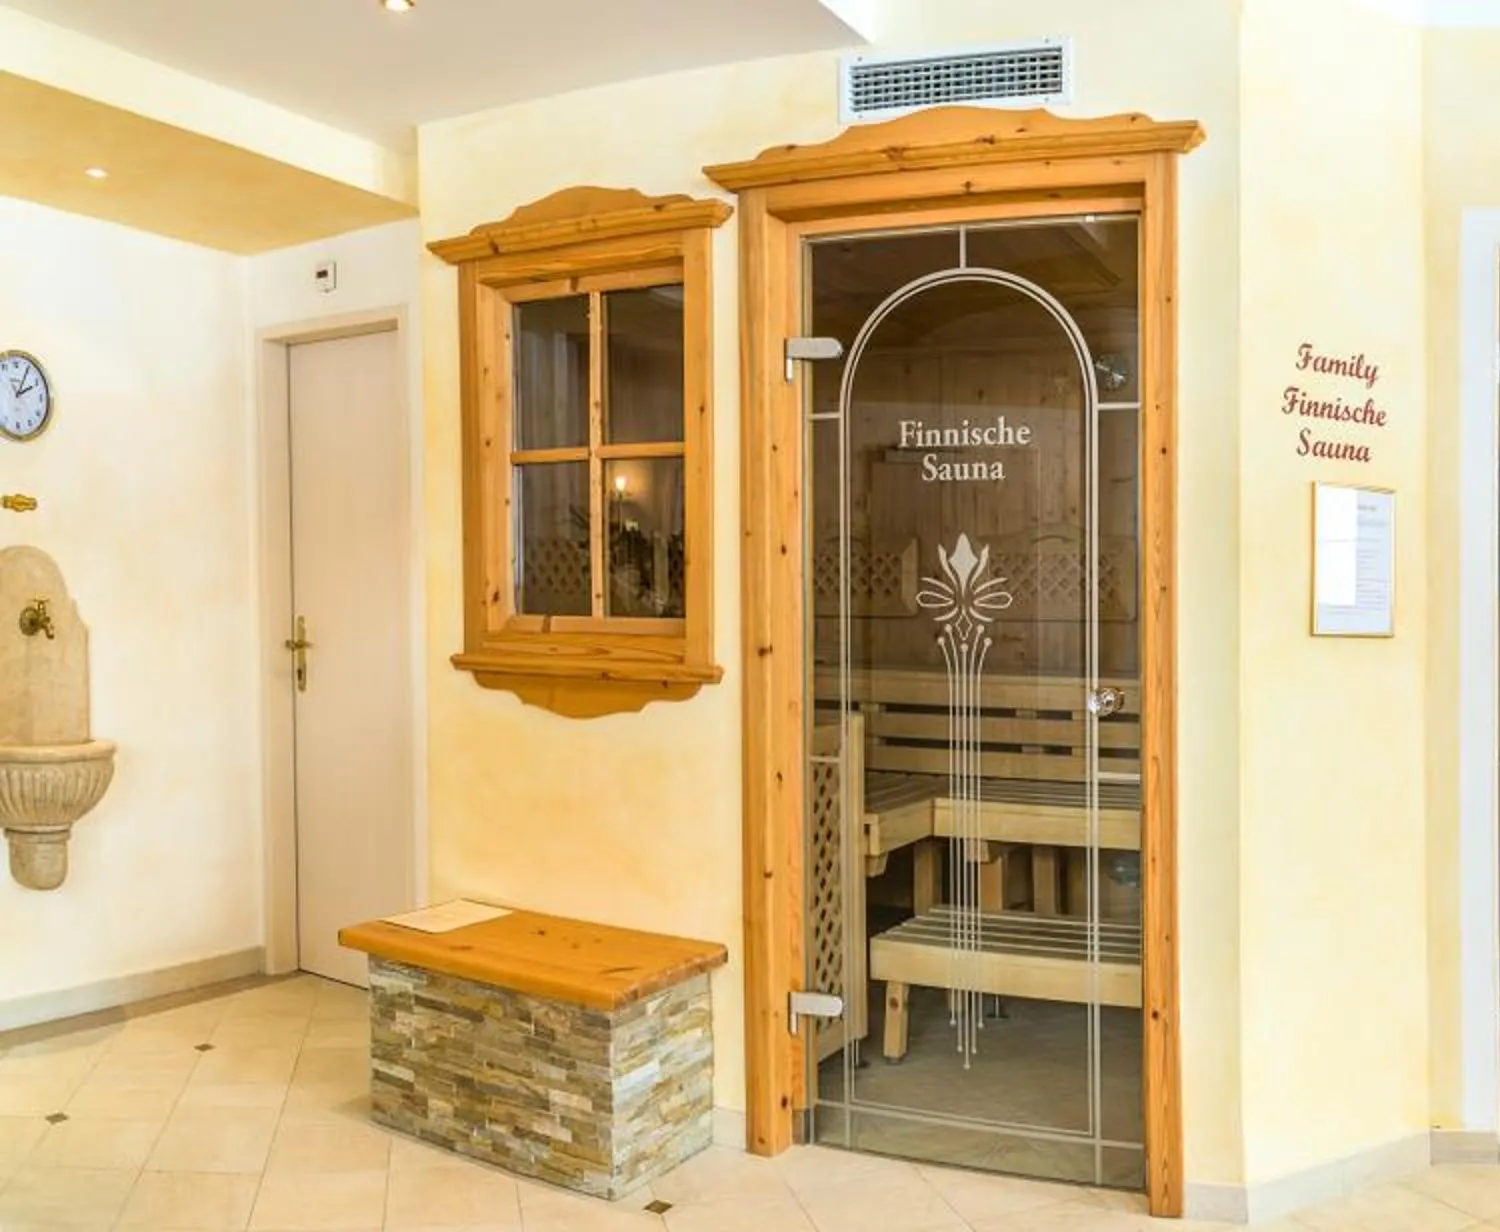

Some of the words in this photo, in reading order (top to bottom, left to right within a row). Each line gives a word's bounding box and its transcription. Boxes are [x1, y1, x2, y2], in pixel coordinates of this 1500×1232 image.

[1295, 342, 1379, 389] Family
[1281, 386, 1387, 427] Finnische
[898, 415, 1032, 448] Finnische
[1296, 427, 1372, 463] Sauna
[921, 453, 1006, 481] Sauna
